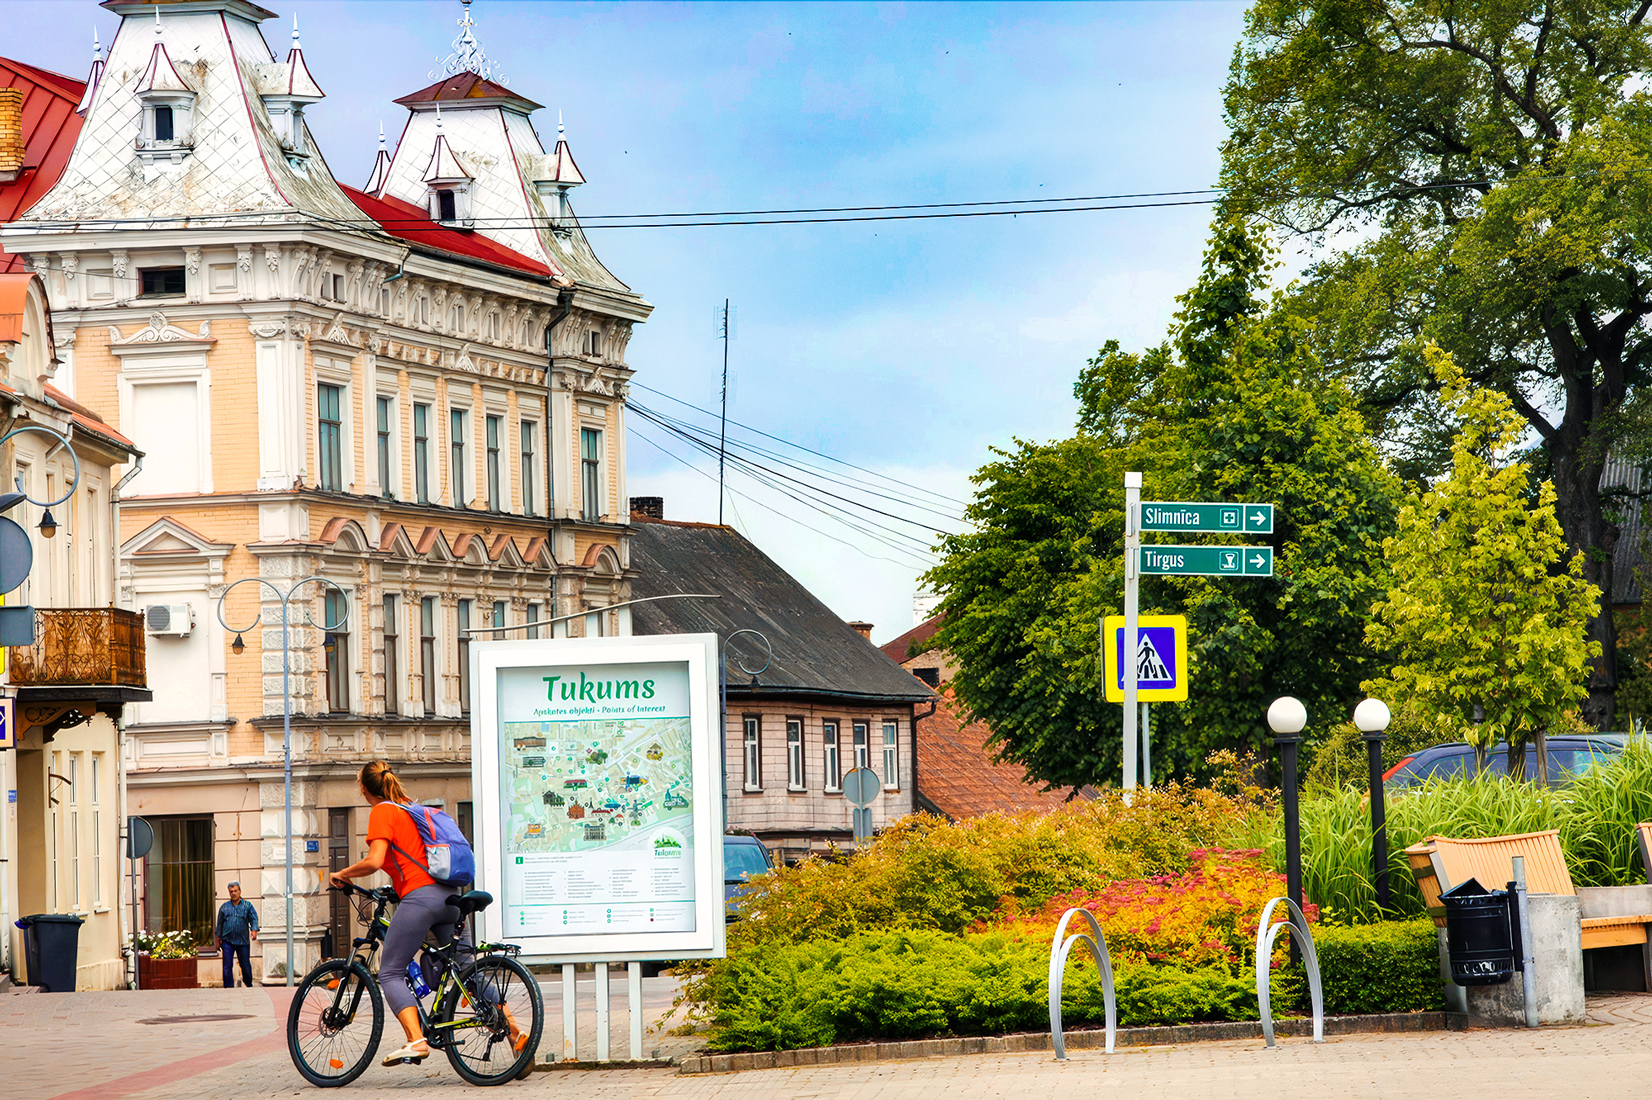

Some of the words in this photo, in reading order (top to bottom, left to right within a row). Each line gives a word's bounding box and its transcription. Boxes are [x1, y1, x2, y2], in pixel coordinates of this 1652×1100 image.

[1145, 508, 1200, 525] Slimnīca
[1145, 551, 1184, 570] Tirgus
[542, 671, 656, 704] Tukums
[569, 706, 595, 716] objekti
[602, 706, 625, 714] Points
[626, 705, 636, 714] of
[637, 705, 666, 713] Interest
